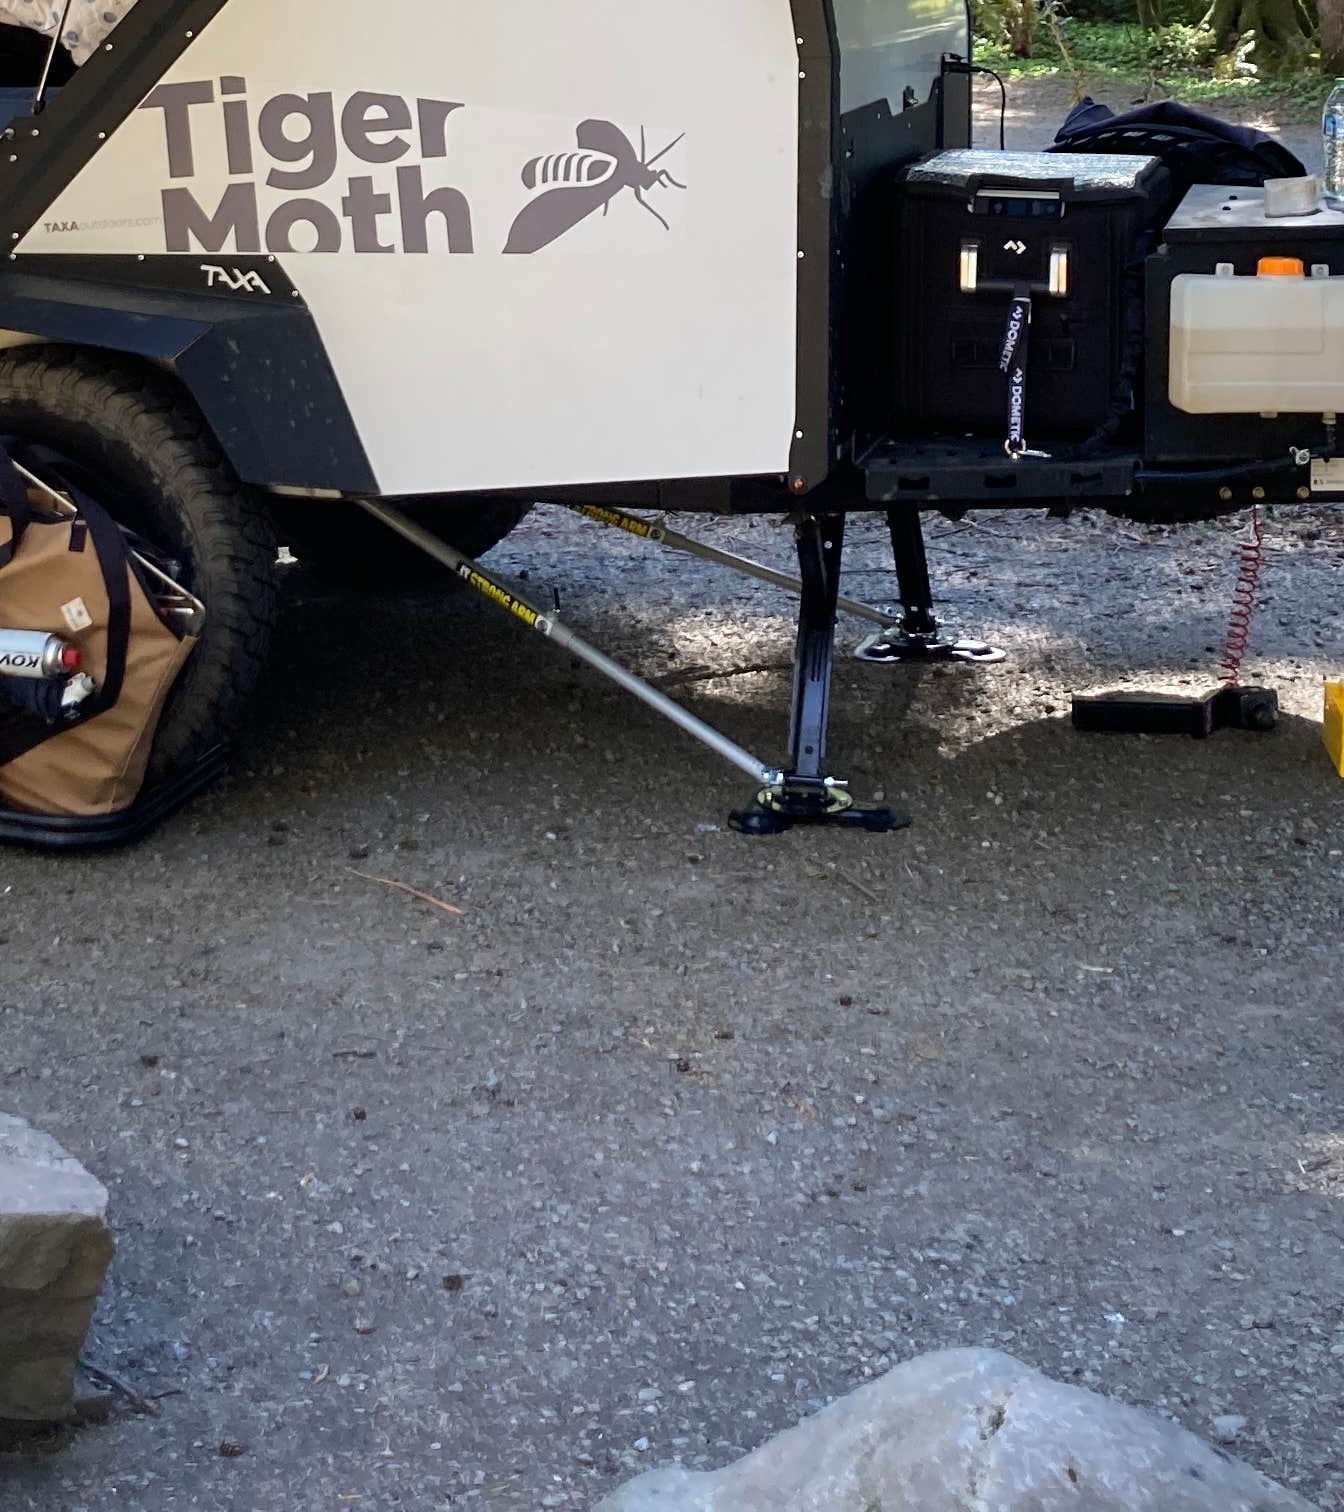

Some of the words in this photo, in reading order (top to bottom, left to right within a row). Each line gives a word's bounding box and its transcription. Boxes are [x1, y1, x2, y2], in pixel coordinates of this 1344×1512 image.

[137, 75, 465, 190] Tiger
[161, 165, 474, 254] Moth
[1000, 320, 1020, 373] DOMETIC
[1010, 385, 1023, 442] DOMETIC
